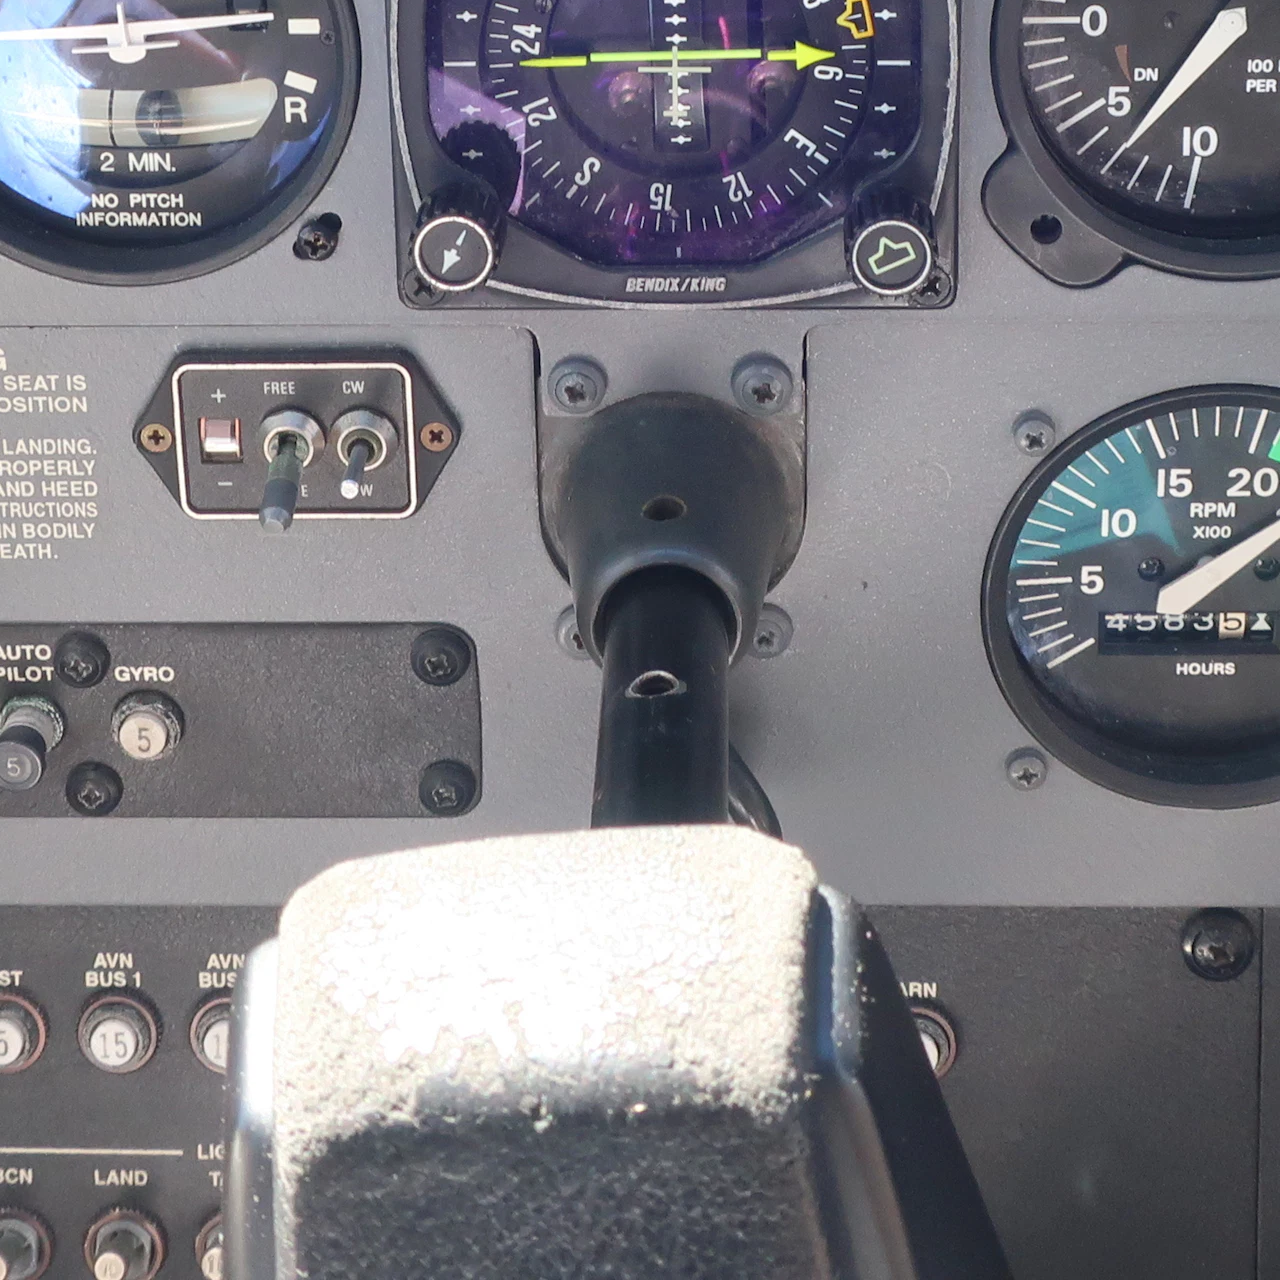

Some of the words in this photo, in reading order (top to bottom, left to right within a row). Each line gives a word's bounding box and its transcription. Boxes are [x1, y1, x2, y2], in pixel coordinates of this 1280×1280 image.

[1134, 67, 1159, 82] DN
[1245, 78, 1277, 93] PER
[99, 151, 115, 172] 2
[128, 152, 176, 172] MIN.
[91, 194, 117, 208] NO
[129, 192, 184, 209] PITCH
[76, 211, 201, 226] INFORMATION
[263, 381, 295, 395] FREE
[342, 380, 365, 394] CW
[1156, 468, 1193, 498] 15
[1189, 502, 1236, 518] RPM
[114, 665, 175, 682] GYRO
[1176, 662, 1236, 676] HOURS
[94, 1169, 148, 1186] LAND
